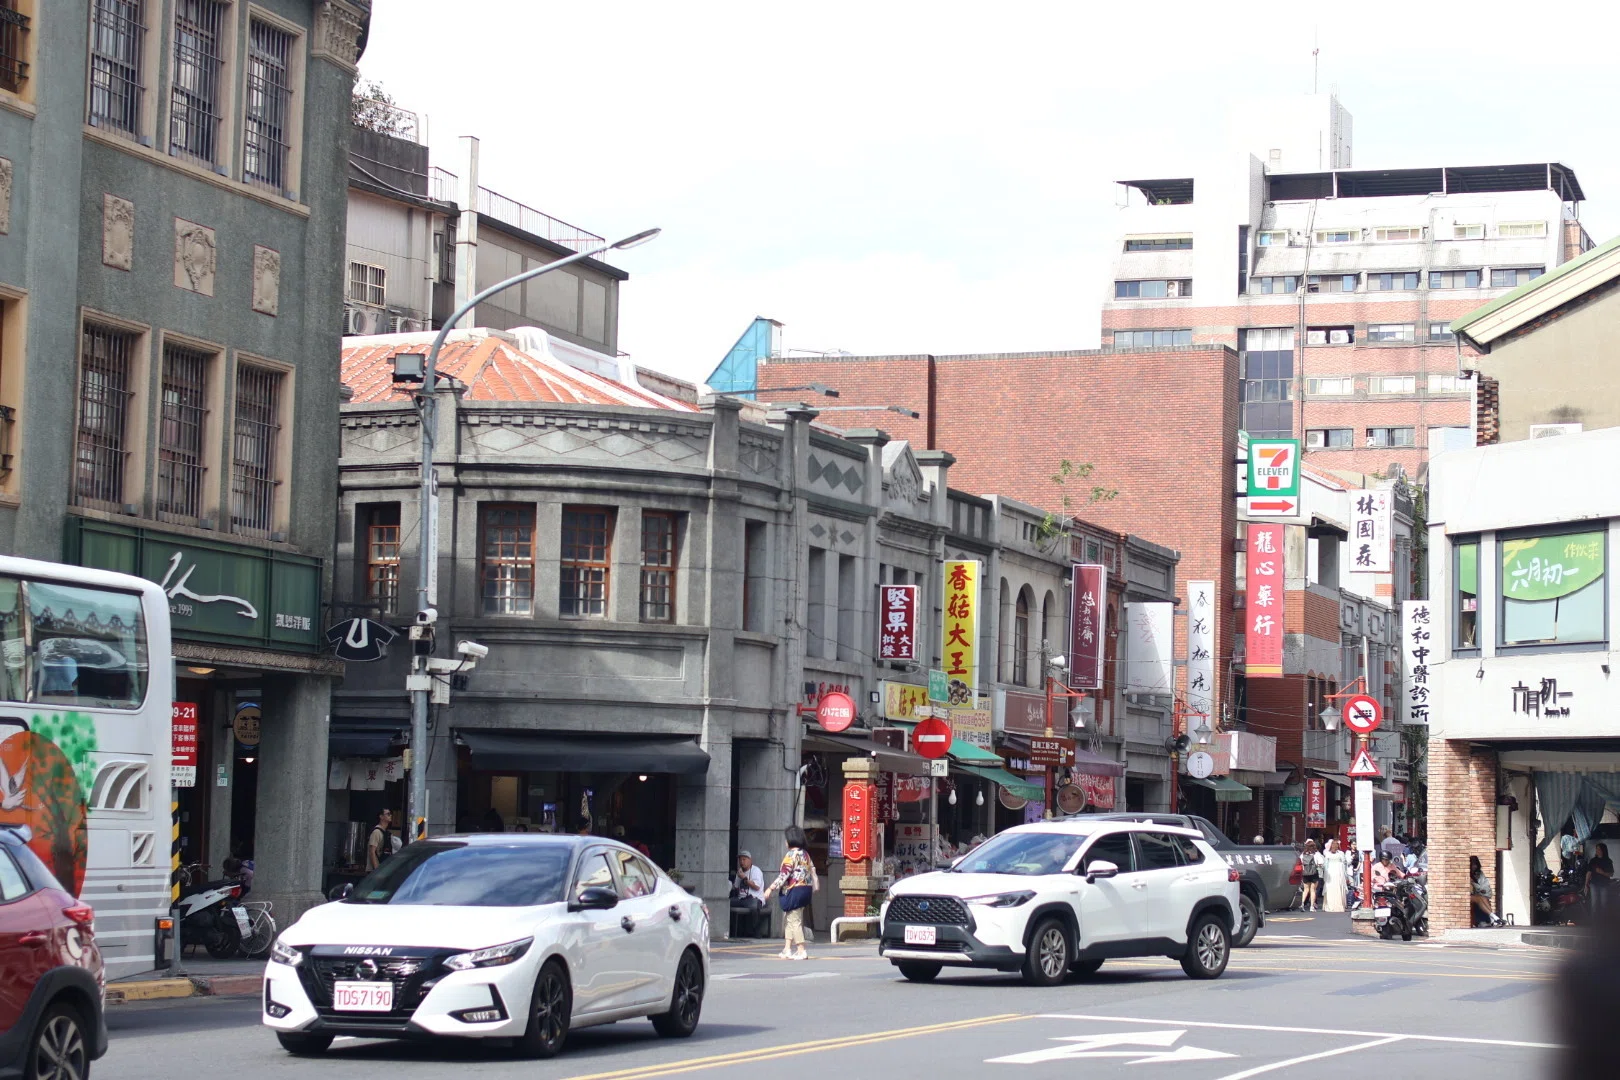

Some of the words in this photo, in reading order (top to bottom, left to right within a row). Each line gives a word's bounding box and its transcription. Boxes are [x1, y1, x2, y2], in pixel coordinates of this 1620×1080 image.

[1355, 494, 1378, 567] 林國森
[1511, 557, 1579, 592] 六月初一
[885, 588, 910, 633] 堅果
[946, 564, 972, 675] 香菇大王
[899, 634, 911, 656] 大王
[1409, 606, 1430, 722] 德和中醫診所
[820, 706, 850, 718] 小花園
[344, 946, 393, 956] NISSAN
